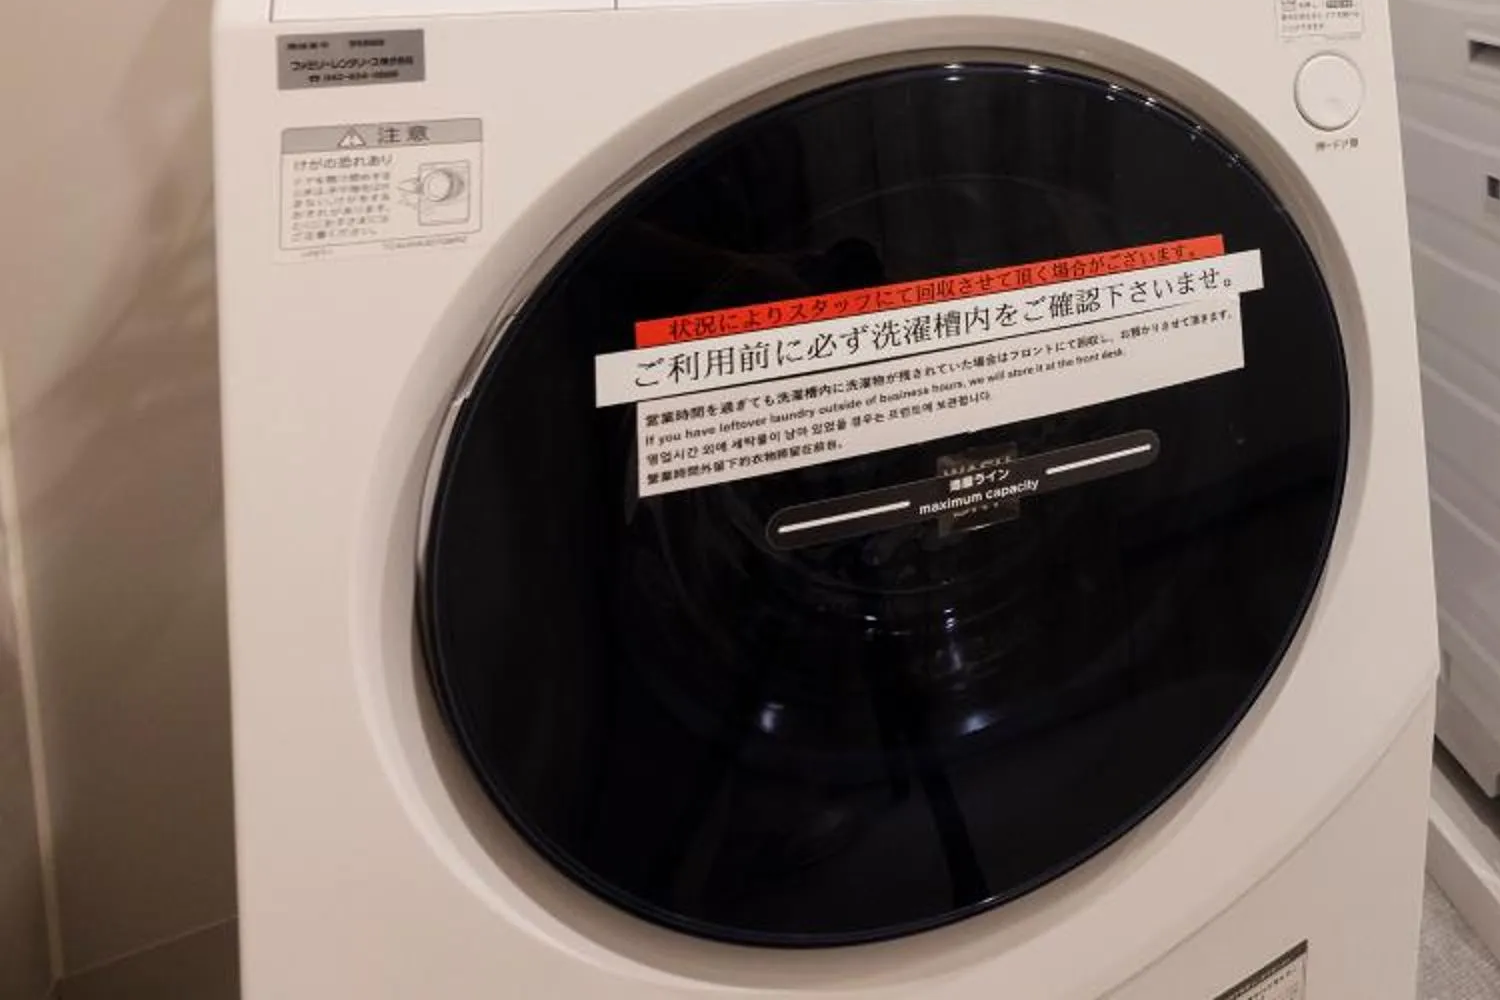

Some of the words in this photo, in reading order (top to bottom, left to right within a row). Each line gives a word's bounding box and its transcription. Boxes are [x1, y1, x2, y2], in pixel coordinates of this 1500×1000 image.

[377, 125, 430, 145] 注意
[668, 244, 1197, 341] 状況によりスタッフにて回収させて頂く場合がございます。
[635, 267, 1233, 389] ご利用前に必ず洗濯槽内をご確認下さいませ。
[645, 434, 655, 446] If
[658, 432, 682, 446] you
[684, 425, 716, 439] have
[719, 416, 767, 432] leftover
[769, 406, 815, 424] laundry
[819, 396, 863, 415] outside
[865, 394, 878, 407] of
[879, 386, 930, 404] business
[969, 376, 985, 386] we
[987, 370, 1006, 382] will
[1007, 366, 1034, 380] store
[1045, 359, 1055, 371] at
[1057, 356, 1075, 369] the
[1075, 352, 1100, 366] front
[919, 492, 983, 515] maximum
[985, 479, 1040, 501] capacity
[949, 469, 1010, 492] ライン
